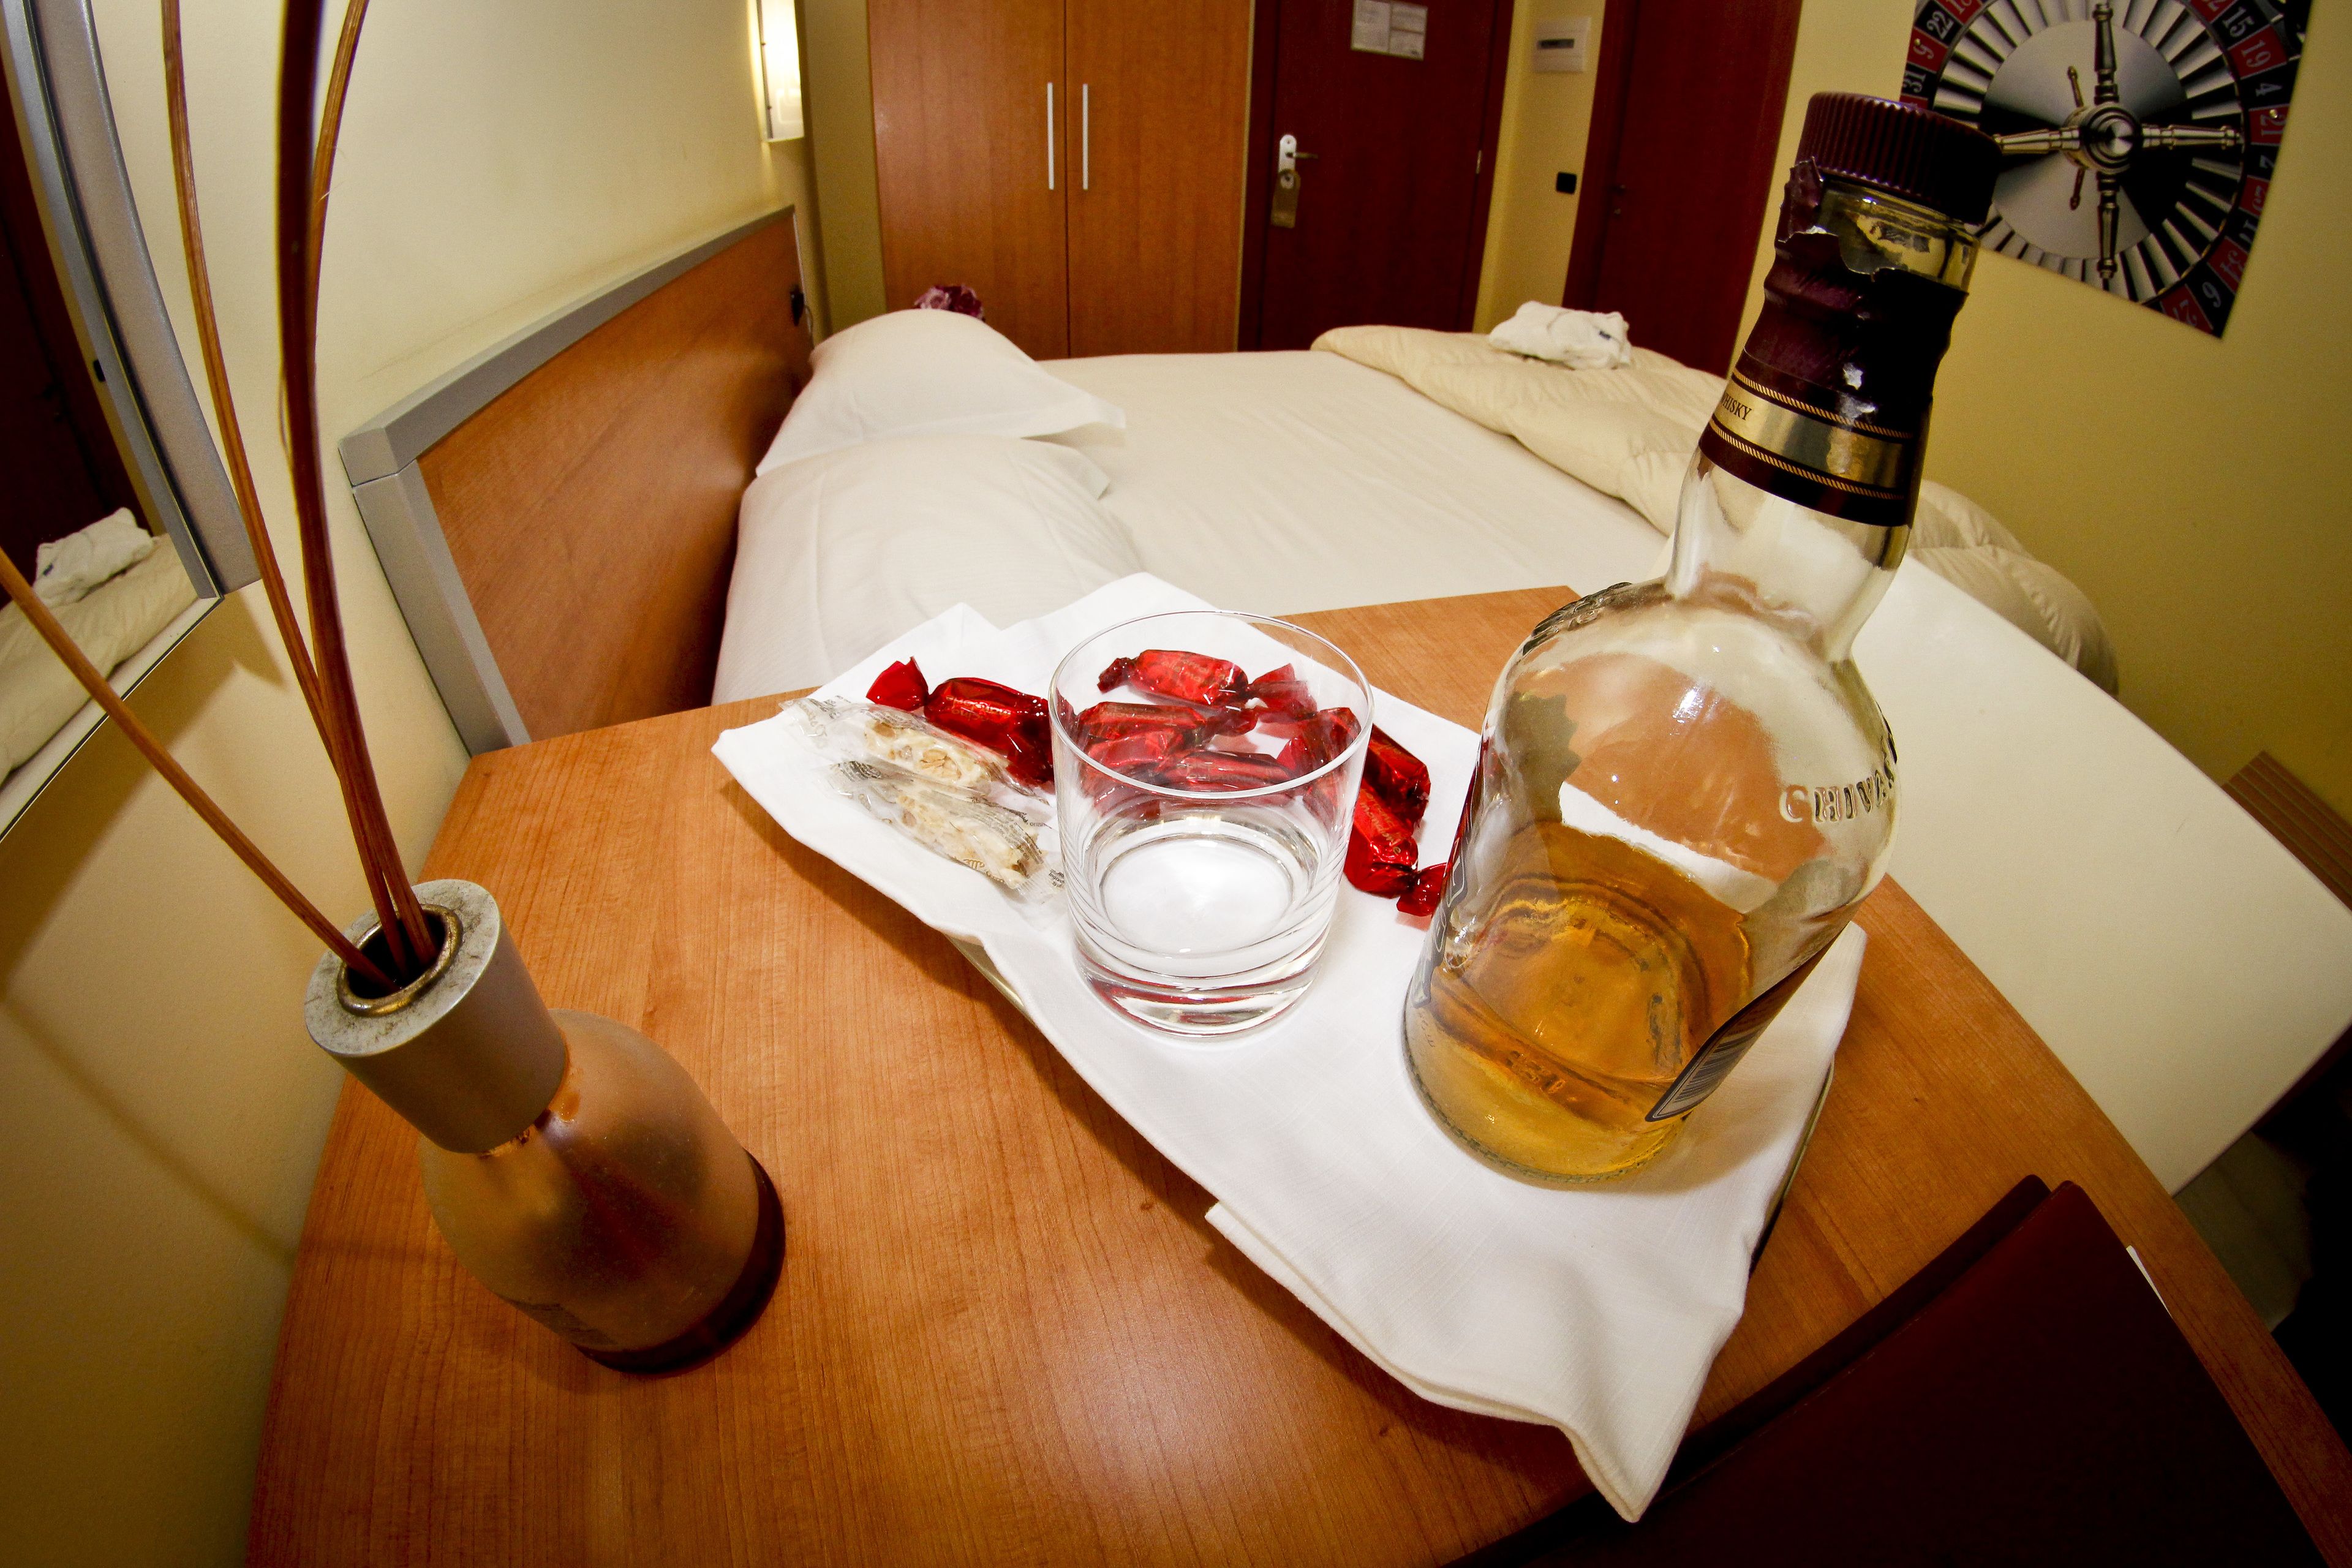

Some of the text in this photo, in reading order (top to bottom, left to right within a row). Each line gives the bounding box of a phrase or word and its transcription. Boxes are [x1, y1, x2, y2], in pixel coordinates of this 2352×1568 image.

[1926, 10, 1954, 40] 22
[2222, 5, 2255, 38] 15
[2241, 39, 2272, 68] 19
[2255, 82, 2283, 97] 4
